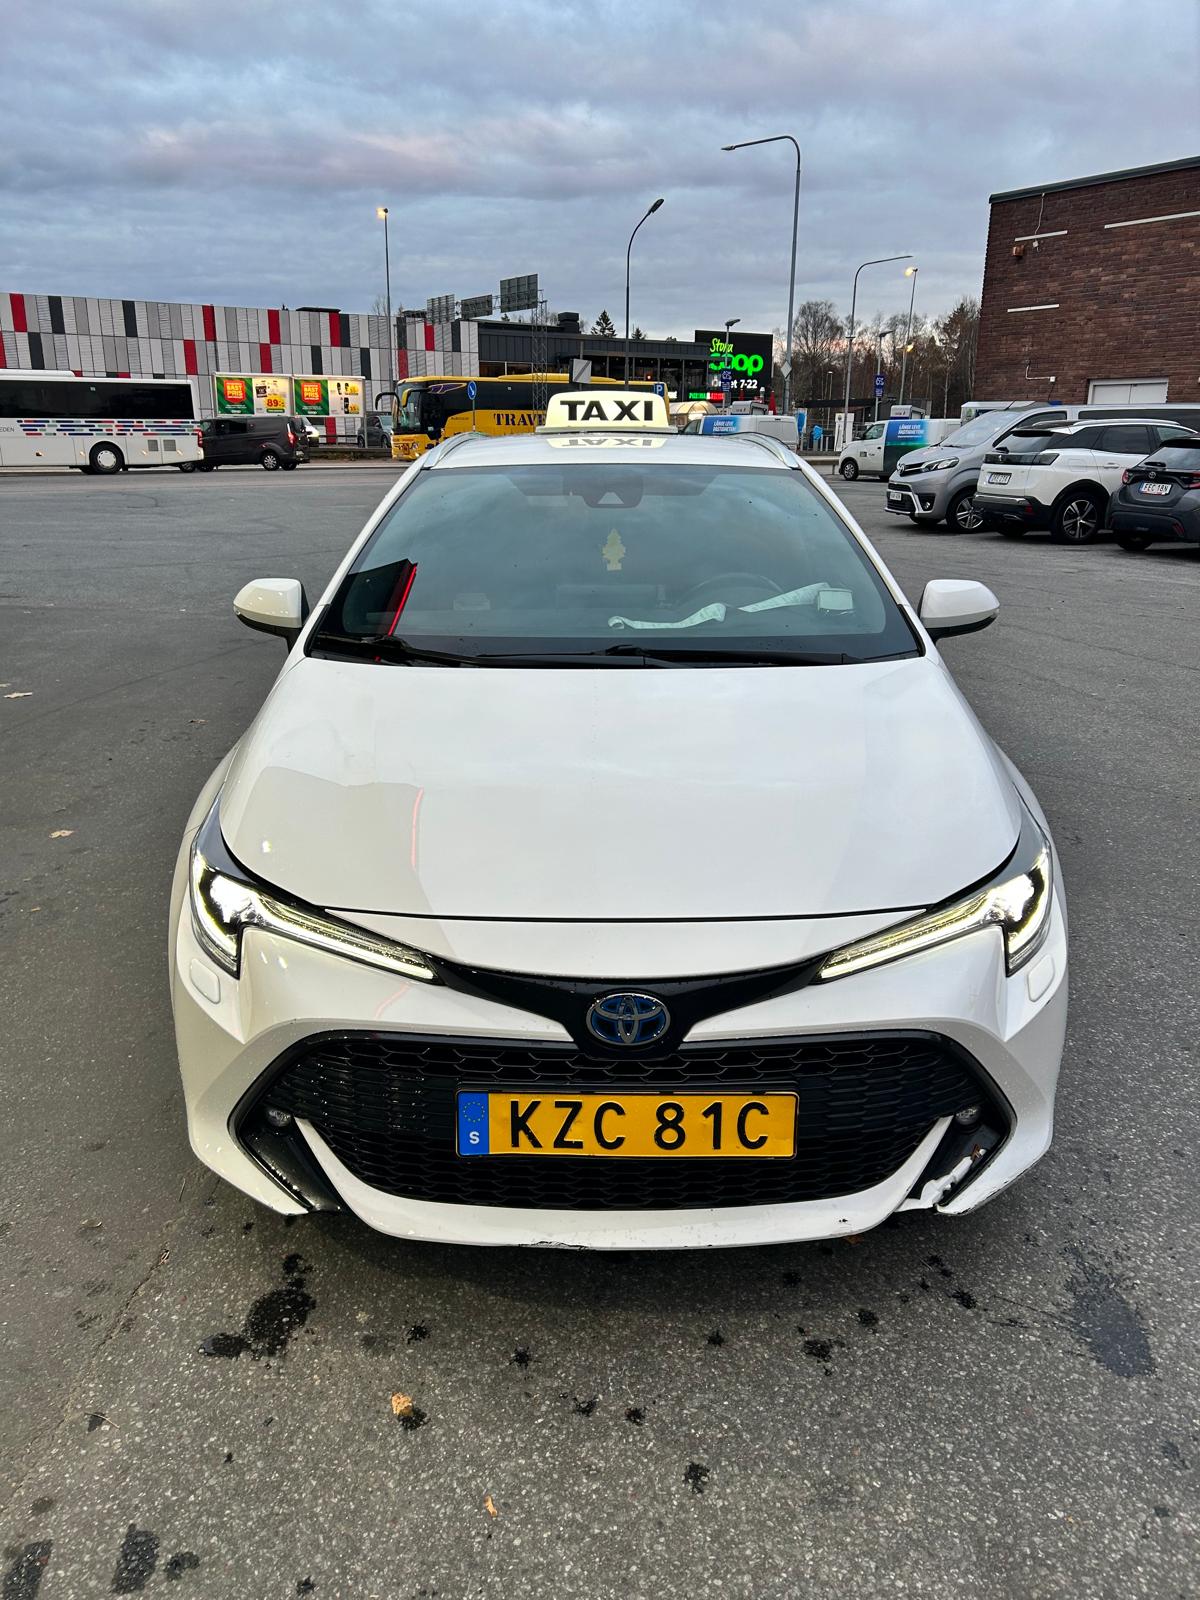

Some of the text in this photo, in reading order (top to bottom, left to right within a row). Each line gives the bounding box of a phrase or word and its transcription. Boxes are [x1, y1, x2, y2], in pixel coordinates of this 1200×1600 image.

[656, 384, 663, 395] P
[740, 379, 758, 388] 7-22
[560, 400, 653, 422] TAXI
[510, 1100, 770, 1151] KZC 81C
[469, 1131, 480, 1145] S
